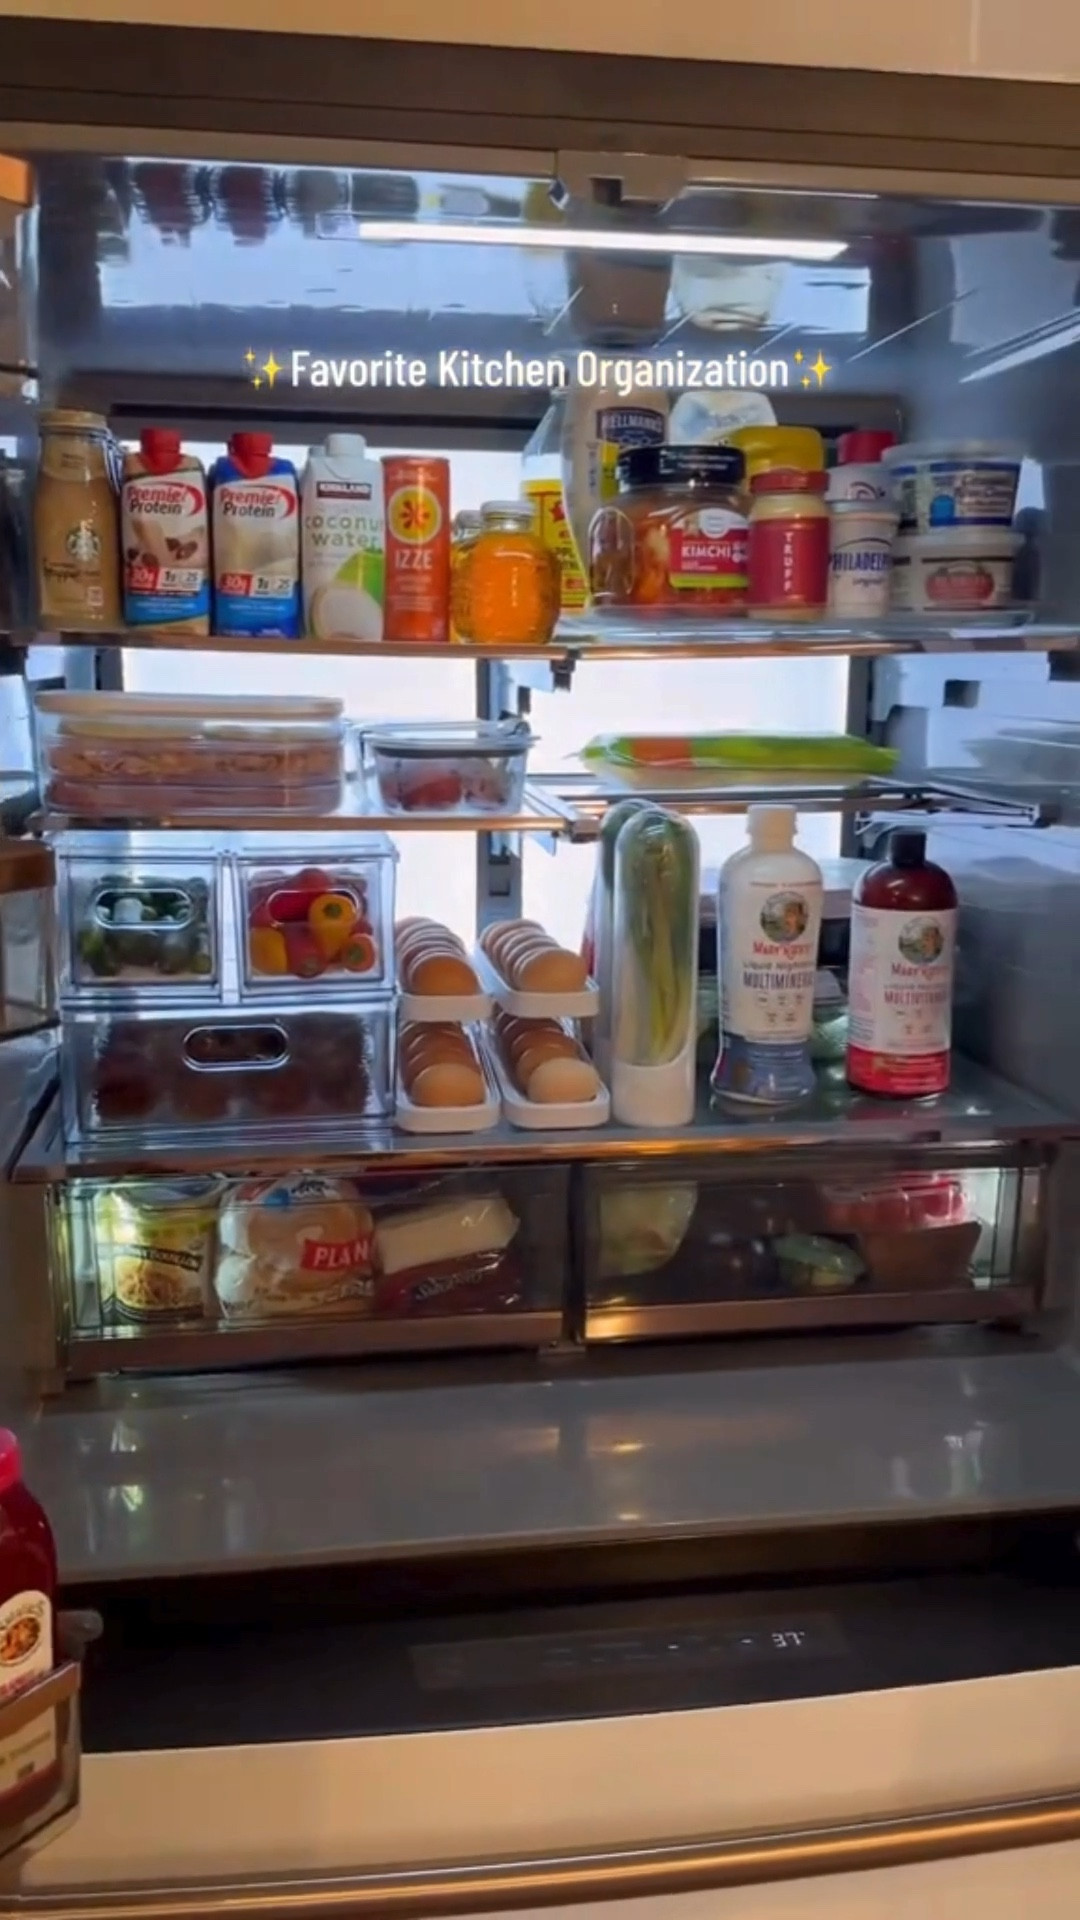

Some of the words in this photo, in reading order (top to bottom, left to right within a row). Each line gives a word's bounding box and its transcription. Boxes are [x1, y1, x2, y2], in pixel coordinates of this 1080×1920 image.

[129, 497, 183, 516] Protein
[223, 501, 276, 519] Protein
[311, 531, 379, 551] water
[395, 548, 433, 570] IZZE
[681, 544, 732, 560] KIMCHI
[783, 531, 793, 592] TRUFF
